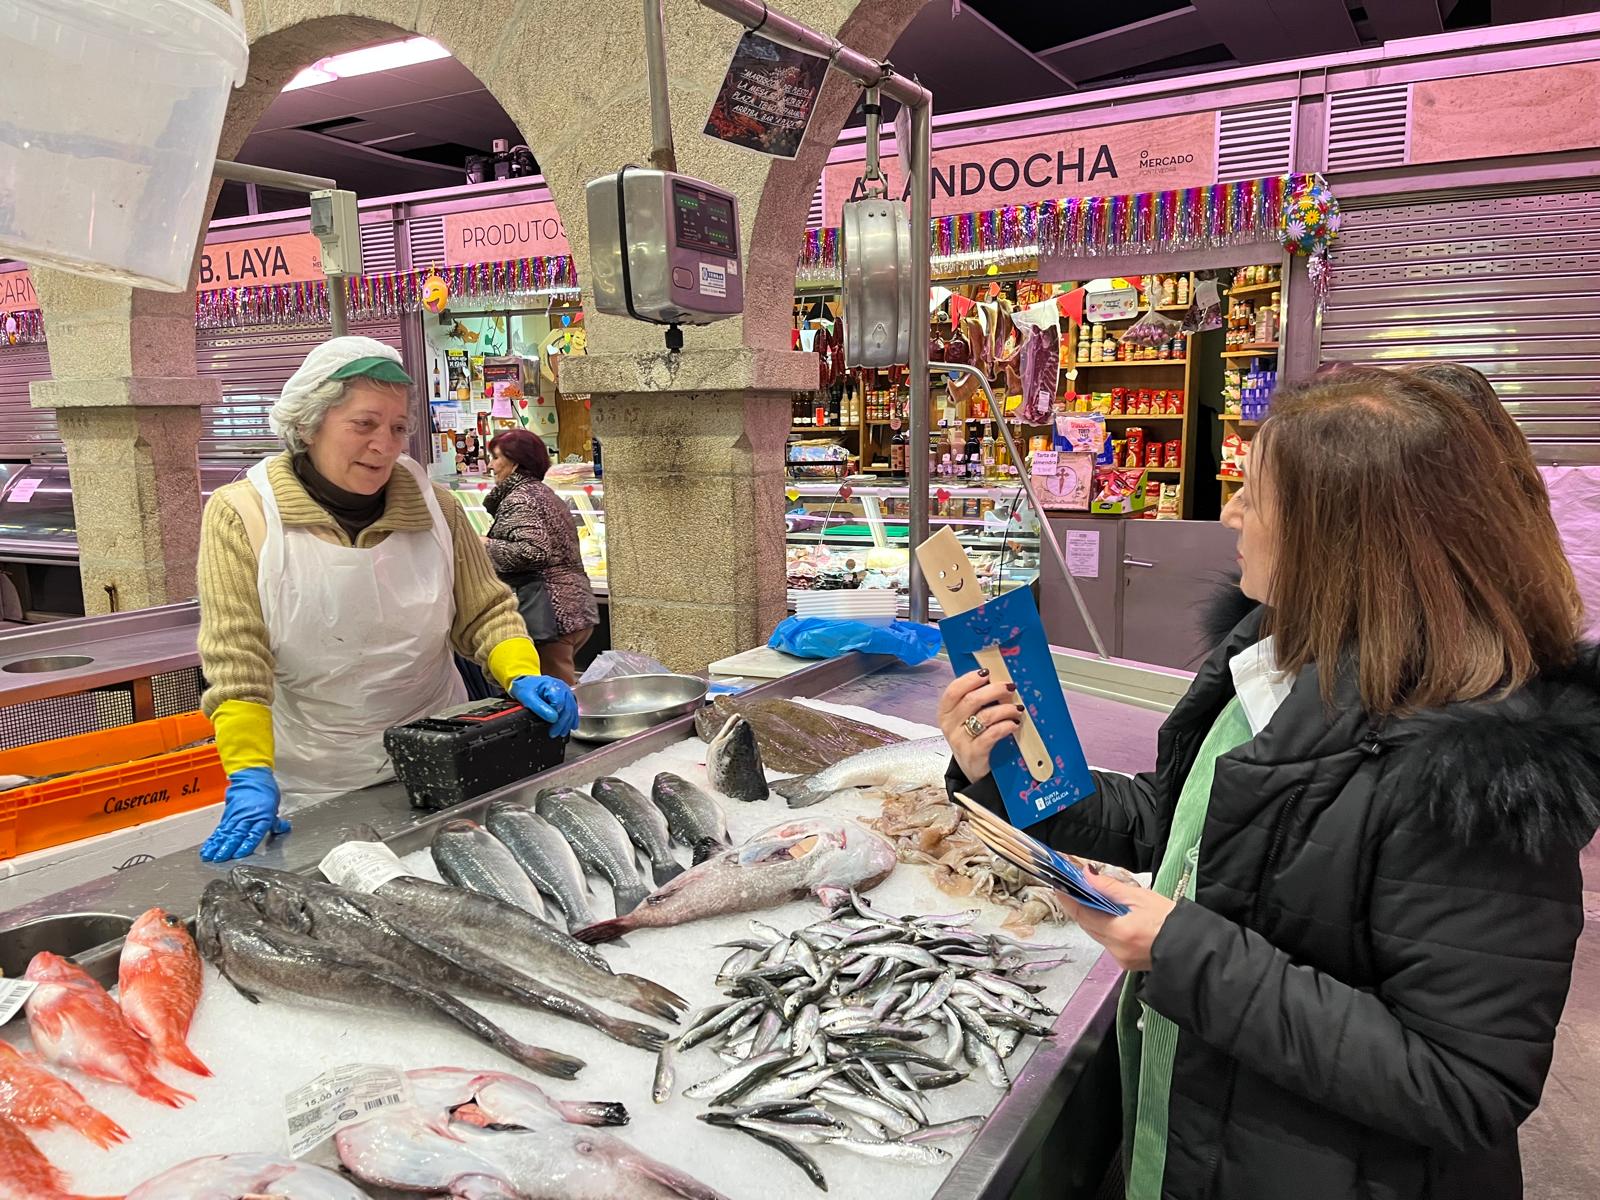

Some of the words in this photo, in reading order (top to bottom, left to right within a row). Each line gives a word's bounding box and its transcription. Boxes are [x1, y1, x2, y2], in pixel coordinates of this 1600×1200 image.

[737, 80, 748, 88] LA
[1139, 154, 1194, 168] MERCADO
[200, 255, 220, 283] B.
[226, 246, 290, 280] LAYA
[104, 789, 170, 814] Casercan,
[181, 777, 200, 796] s.l.
[1052, 791, 1069, 803] GALICIA
